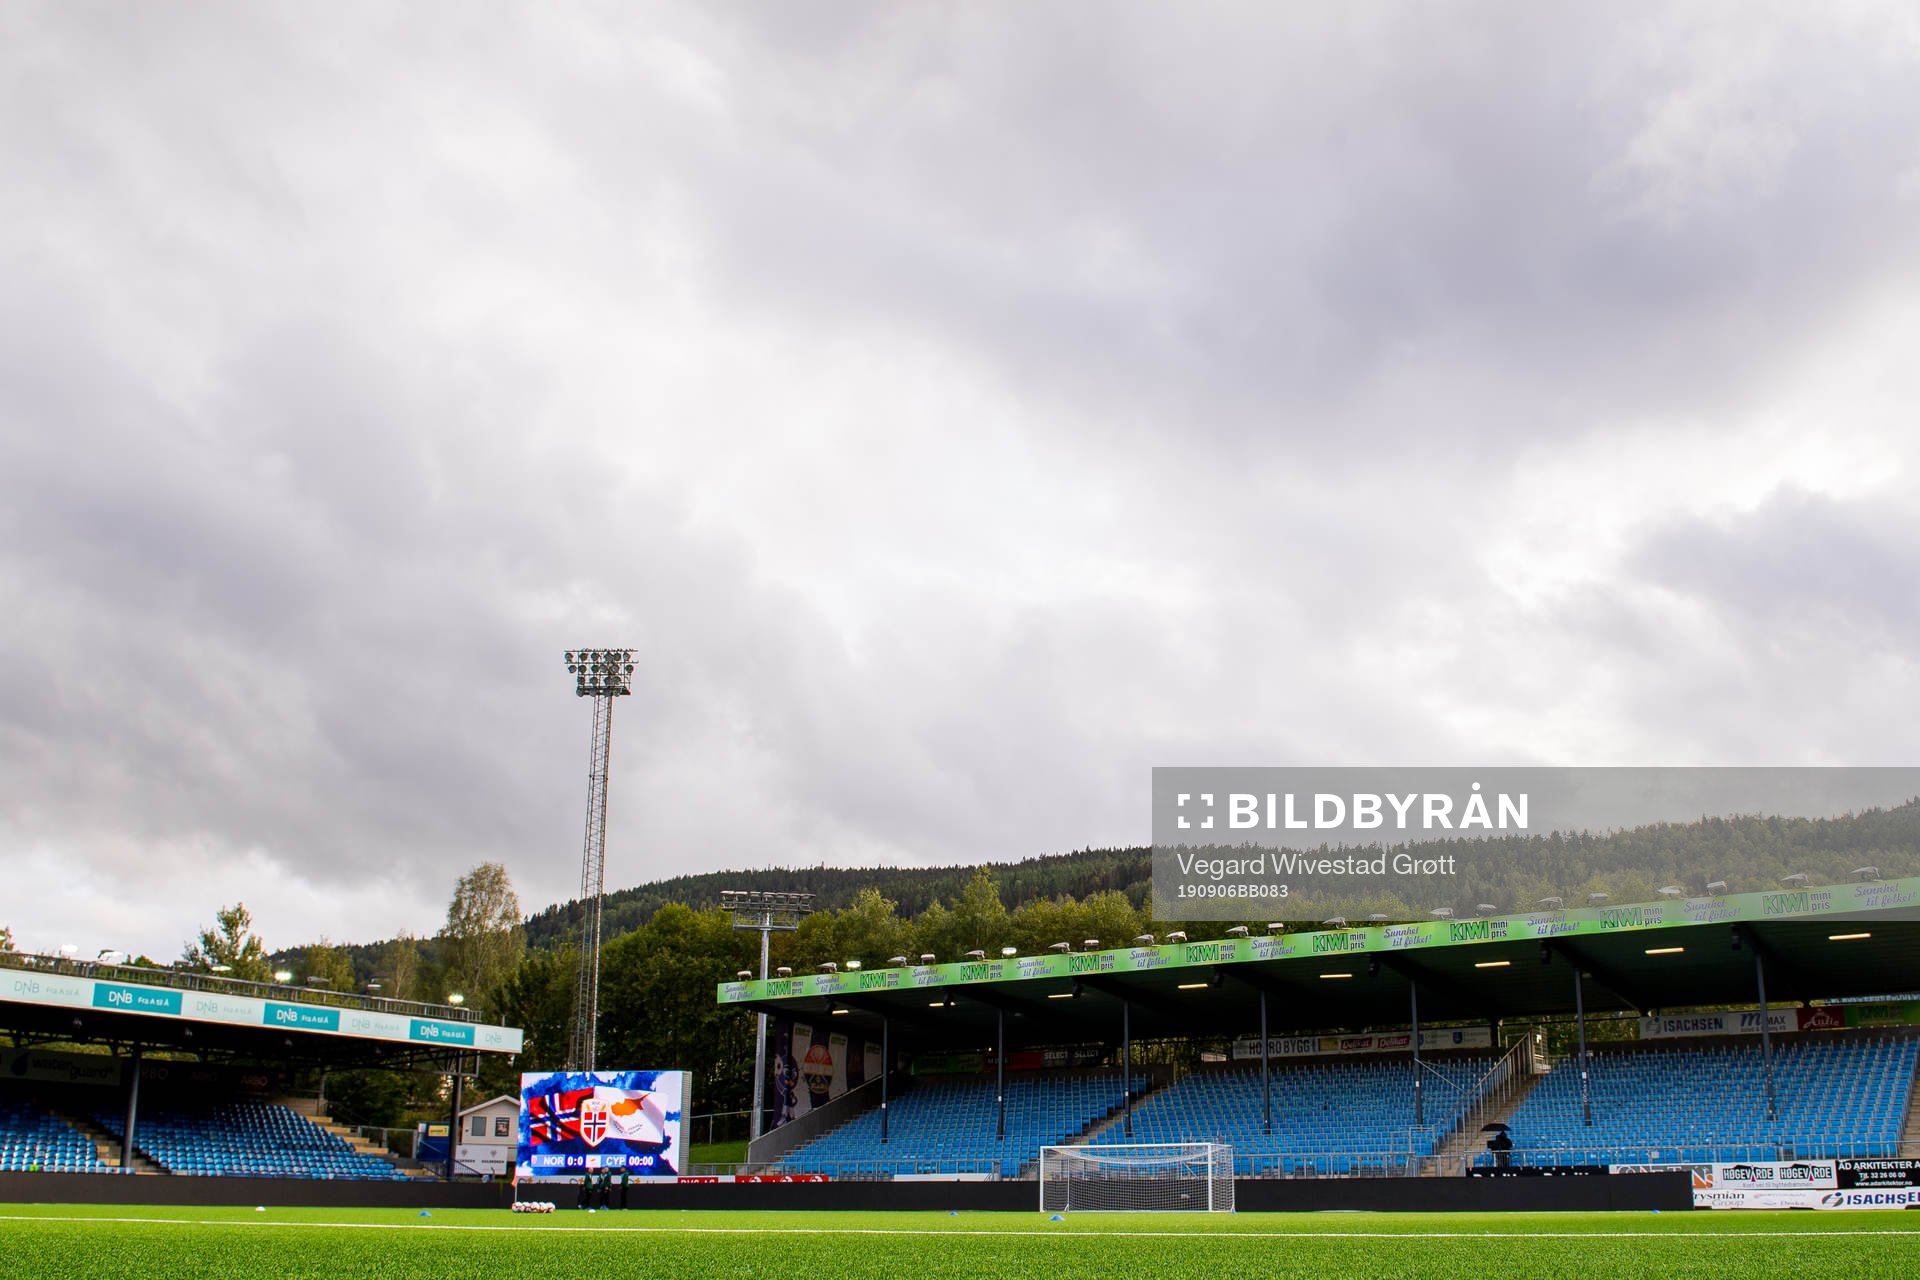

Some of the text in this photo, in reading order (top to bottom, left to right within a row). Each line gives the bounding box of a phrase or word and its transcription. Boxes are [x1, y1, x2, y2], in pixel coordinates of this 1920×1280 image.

[1762, 892, 1810, 914] KIWI
[1600, 907, 1643, 929] KIWI
[1450, 921, 1489, 941] KIWI
[1312, 932, 1349, 952] KIWI
[1186, 944, 1219, 962] KIWI
[1069, 955, 1100, 972] KIWI
[960, 964, 989, 981] KIWI
[108, 989, 133, 1005] DNB
[276, 1008, 298, 1023] DNB
[420, 1024, 439, 1038] DNB
[1664, 1017, 1723, 1032] ISACHSEN
[543, 1155, 653, 1165] NOR 0:0 CYP 00:00
[1853, 1161, 1912, 1170] ARKITEKTER
[1694, 1191, 1745, 1200] rysmian
